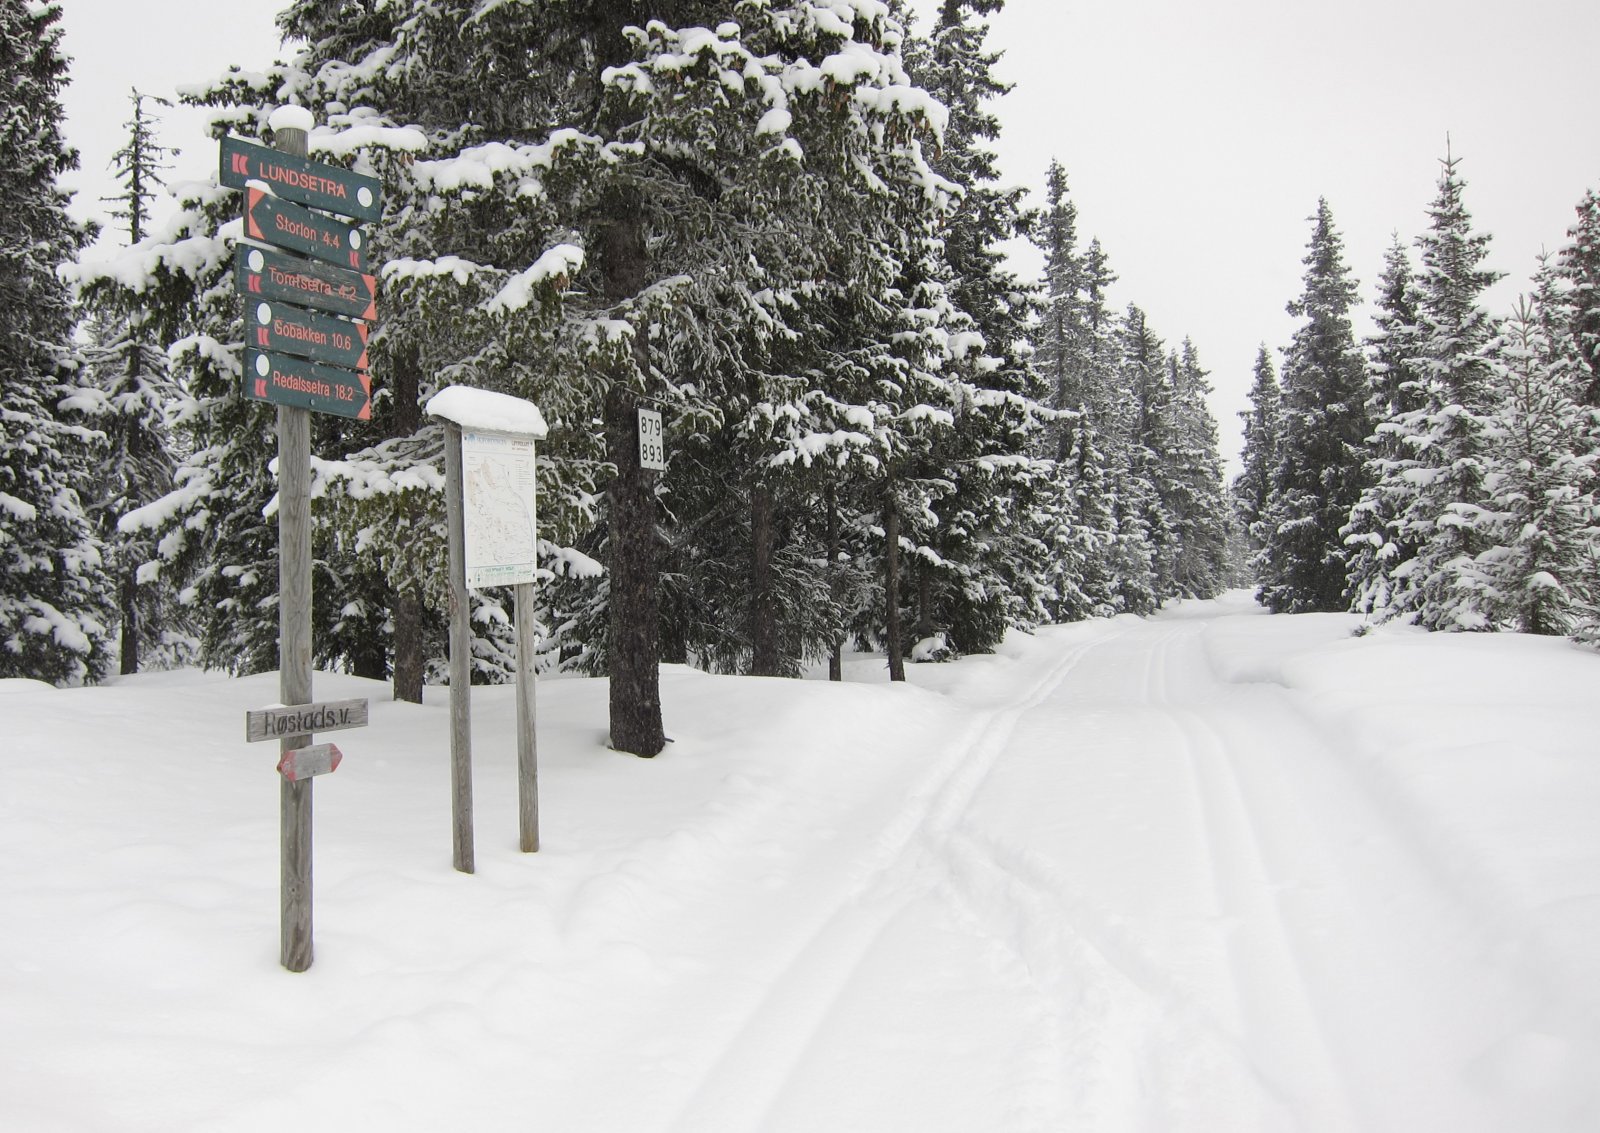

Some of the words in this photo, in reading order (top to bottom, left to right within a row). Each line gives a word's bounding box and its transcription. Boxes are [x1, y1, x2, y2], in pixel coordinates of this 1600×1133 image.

[259, 162, 347, 199] LUNDSETRA
[323, 231, 341, 249] 4.4
[338, 284, 357, 302] 4.2
[331, 333, 352, 351] 10.6
[272, 370, 330, 397] Redalssetra
[334, 383, 354, 401] 18.2
[641, 416, 661, 437] 879
[642, 443, 662, 463] 893
